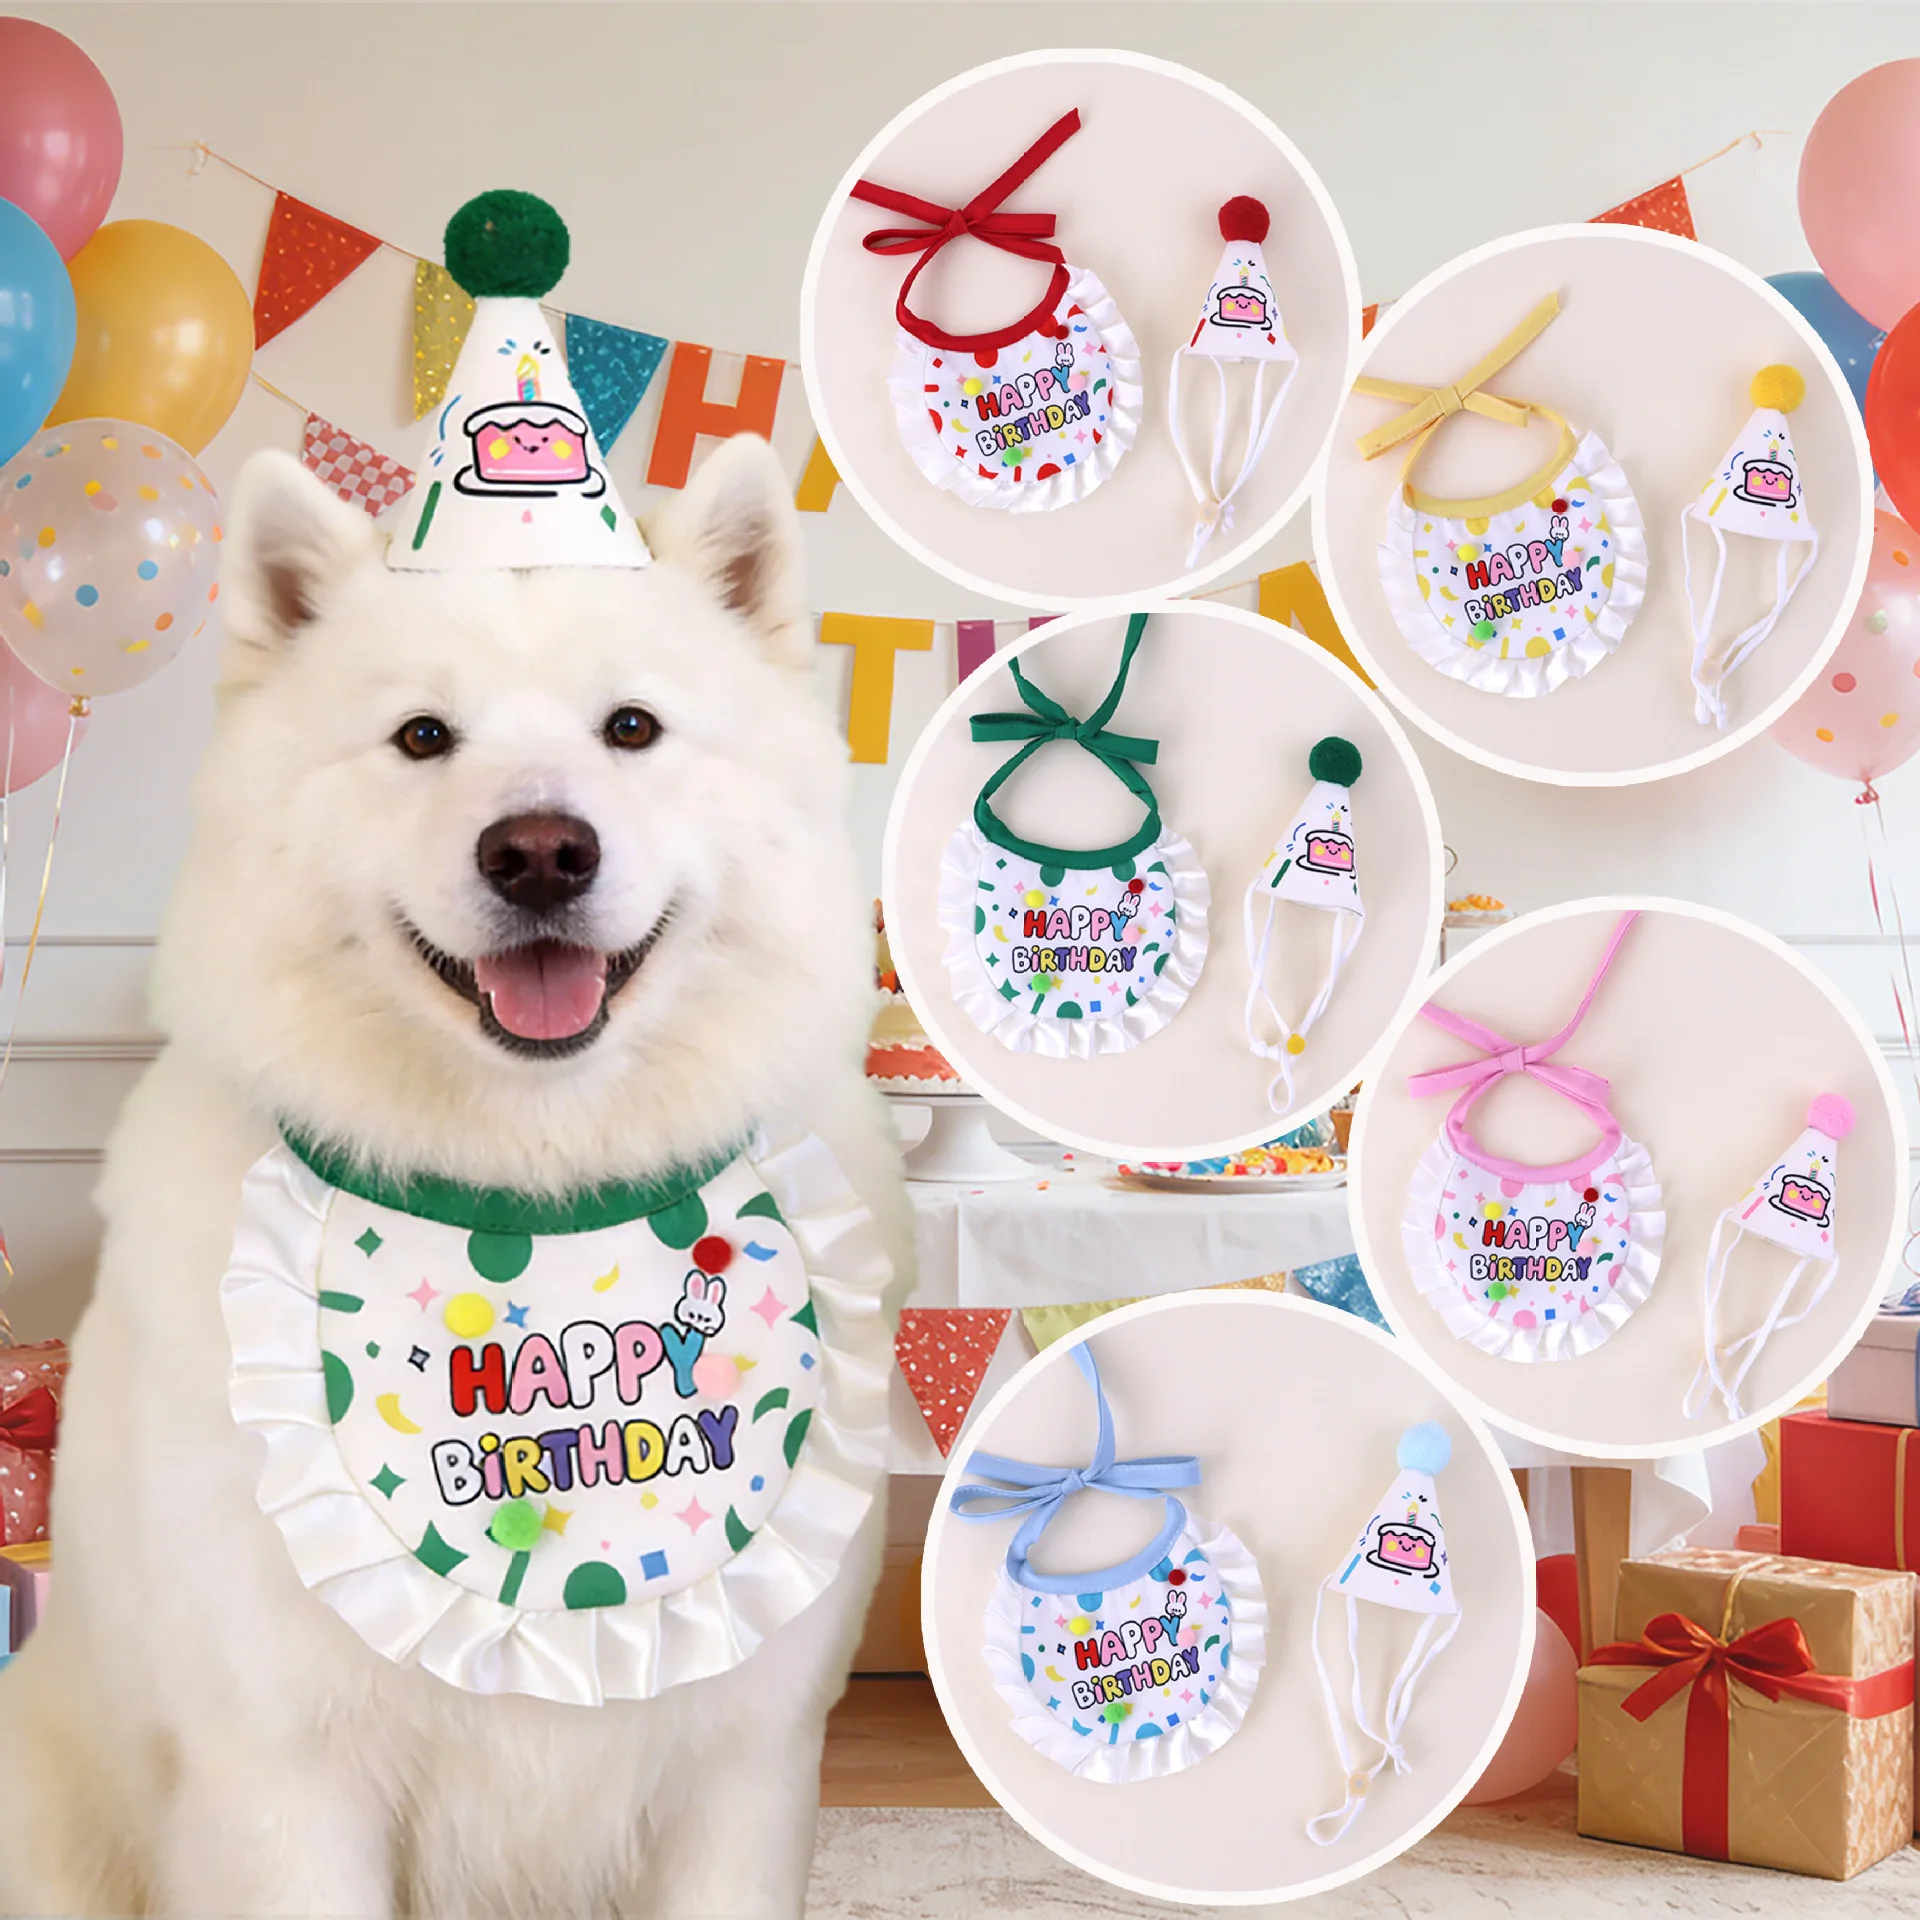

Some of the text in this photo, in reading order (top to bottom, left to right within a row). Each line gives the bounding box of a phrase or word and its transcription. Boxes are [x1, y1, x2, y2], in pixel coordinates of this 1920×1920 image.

[976, 365, 1071, 421] HAPPY
[1466, 538, 1564, 590] HAPPY
[1023, 905, 1129, 942] HAPPY
[1482, 1216, 1585, 1252] HAPPY
[449, 1320, 707, 1417] HAPPY
[1074, 1615, 1181, 1671] HAPPY
